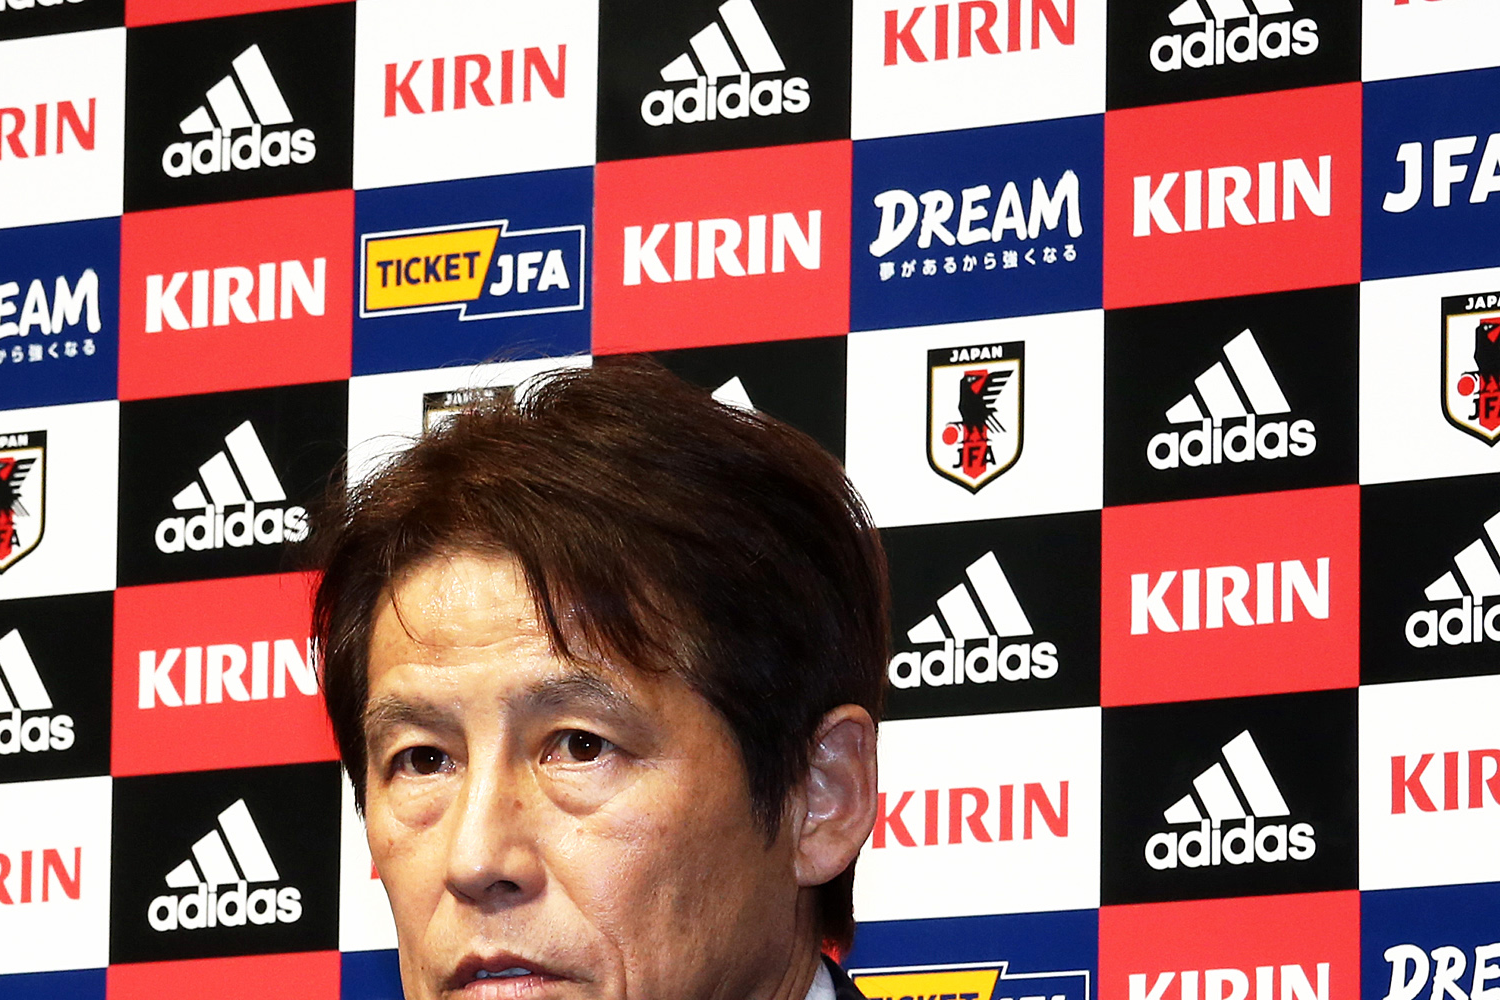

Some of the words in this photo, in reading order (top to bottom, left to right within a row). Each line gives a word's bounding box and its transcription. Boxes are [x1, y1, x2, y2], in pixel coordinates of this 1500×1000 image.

[884, 0, 1075, 65] KIRIN
[1150, 14, 1319, 72] adidas
[385, 45, 566, 117] KIRIN
[641, 71, 810, 126] adidas
[161, 122, 316, 179] adidas
[869, 169, 1083, 257] DREAM
[1133, 155, 1331, 237] KIRIN
[376, 250, 481, 289] TICKET
[489, 249, 570, 296] JFA
[623, 210, 821, 285] KIRIN
[879, 244, 1077, 281] 夢があるから強くなる
[145, 258, 326, 333] KIRIN
[950, 346, 1003, 363] JAPAN
[952, 445, 997, 470] JFA
[1146, 413, 1317, 470] adidas
[155, 498, 310, 554] adidas
[1131, 557, 1329, 635] KIRIN
[138, 638, 317, 709] KIRIN
[888, 635, 1058, 688] adidas
[1391, 748, 1500, 814] KIR
[871, 781, 1069, 849] KIRIN
[1145, 816, 1316, 870] adidas
[148, 881, 302, 931] adidas
